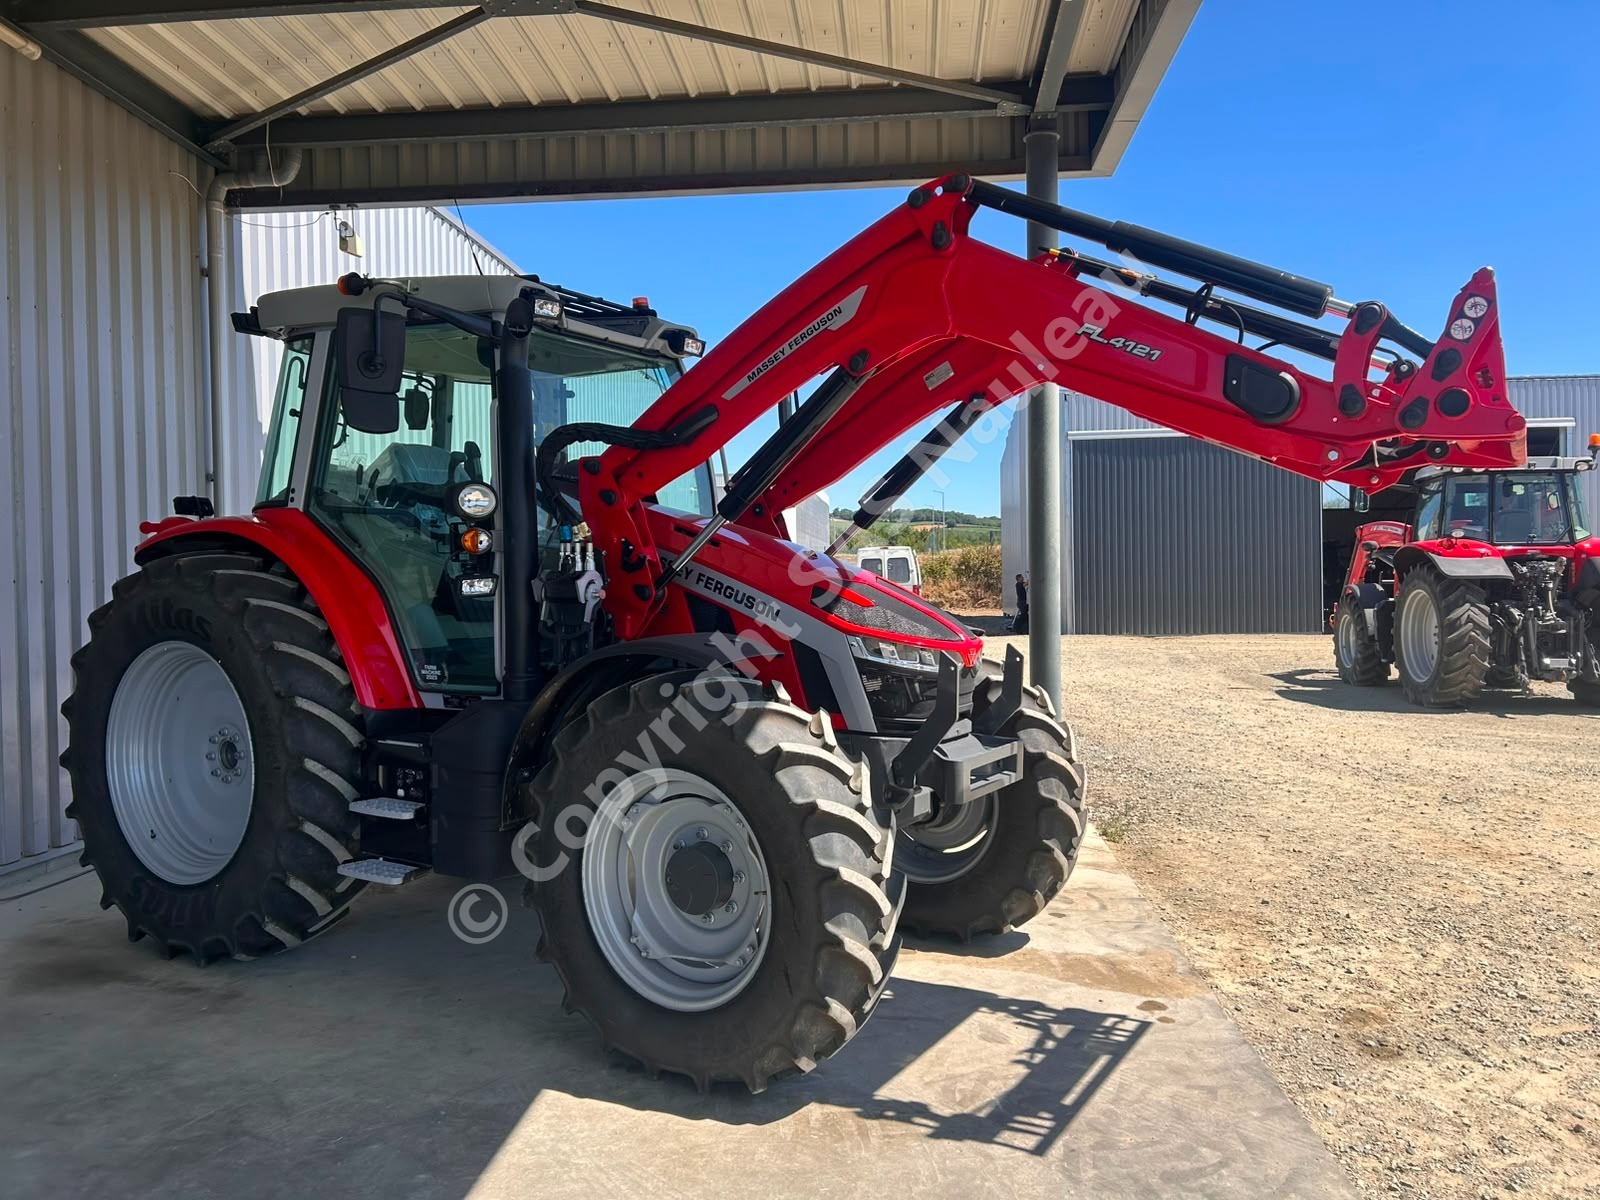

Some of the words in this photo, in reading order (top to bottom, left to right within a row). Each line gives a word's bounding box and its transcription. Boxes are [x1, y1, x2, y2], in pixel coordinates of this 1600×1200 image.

[747, 348, 787, 383] MASSEY
[787, 306, 843, 350] FERGUSON
[1076, 322, 1163, 361] FL.4121
[695, 573, 781, 622] FERGUSON
